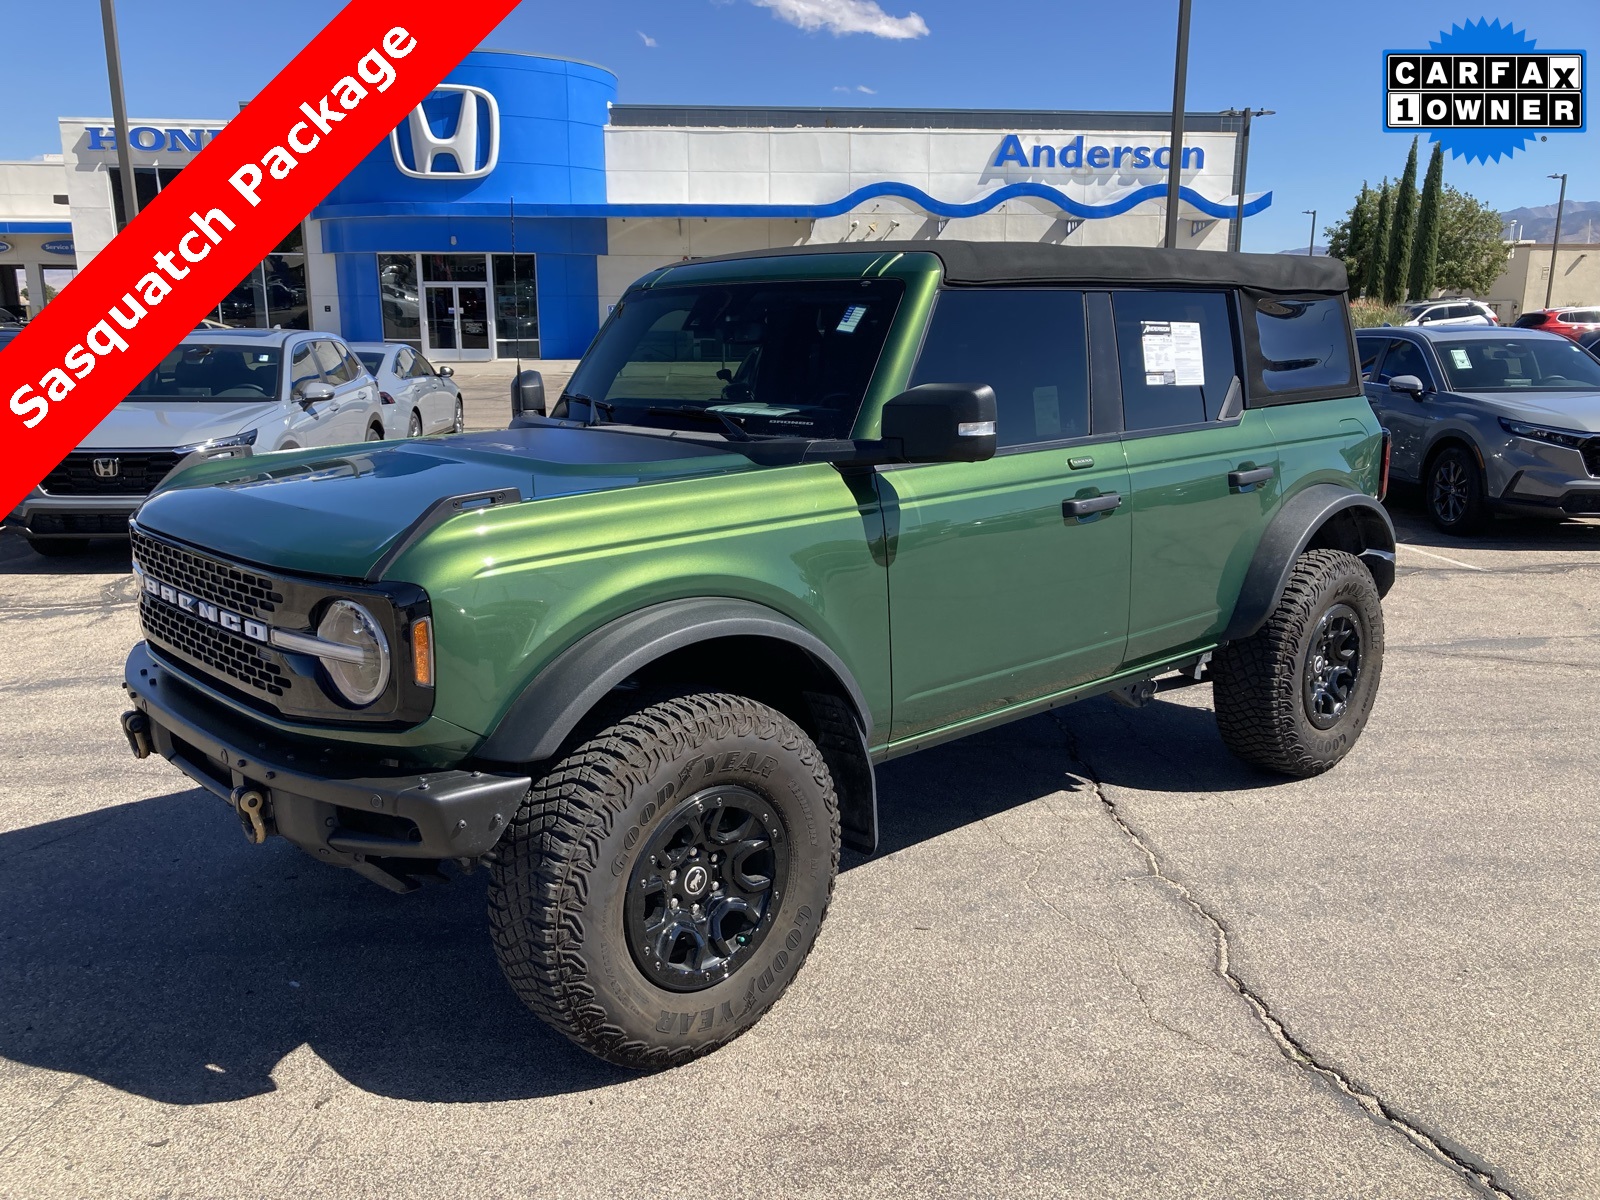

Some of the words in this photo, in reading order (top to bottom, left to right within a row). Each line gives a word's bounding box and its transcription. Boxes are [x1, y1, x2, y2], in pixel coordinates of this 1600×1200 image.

[85, 126, 224, 153] HON
[993, 134, 1205, 170] Anderson
[440, 265, 486, 273] WELCOM
[145, 576, 268, 642] BRONCO
[610, 750, 779, 877] GOODYEAR
[655, 904, 813, 1035] GOODYEAR
